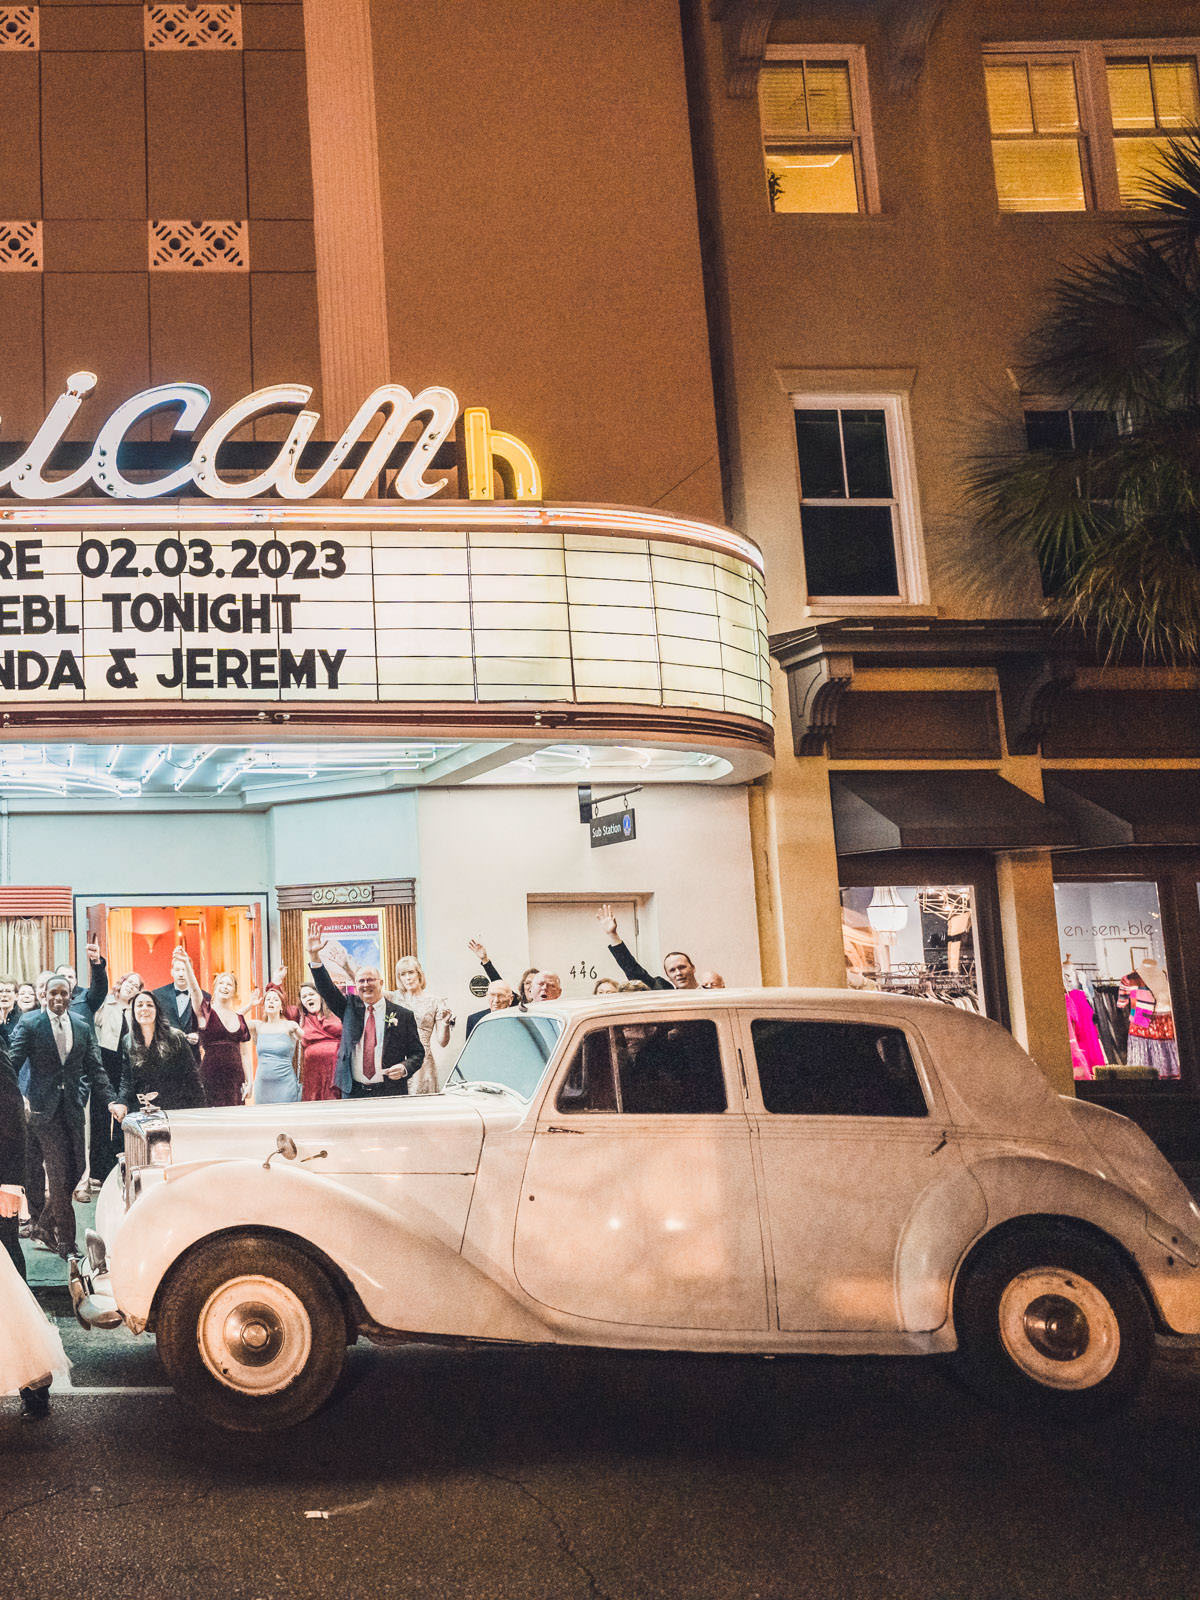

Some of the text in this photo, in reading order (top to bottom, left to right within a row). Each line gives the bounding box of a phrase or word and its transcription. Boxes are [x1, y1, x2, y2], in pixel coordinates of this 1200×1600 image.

[76, 538, 347, 581] 02.03.2023
[102, 592, 303, 635] TONIGHT
[106, 648, 139, 690] &
[157, 647, 348, 690] JEREMY
[591, 823, 622, 838] Sub Station
[352, 922, 379, 930] THEATER
[569, 965, 598, 980] 446
